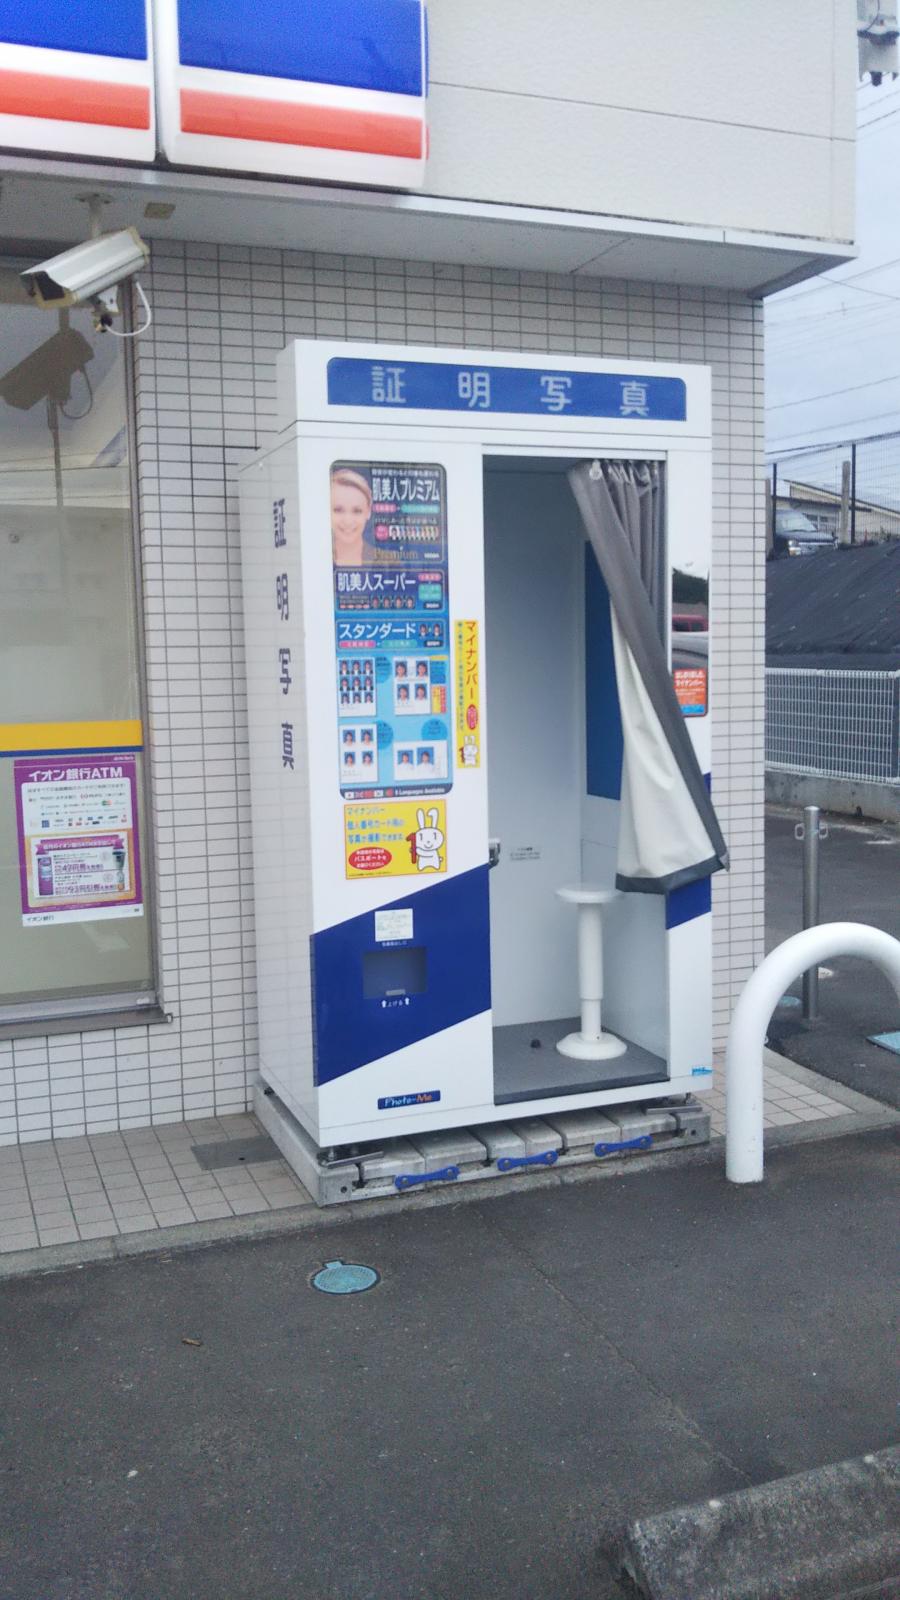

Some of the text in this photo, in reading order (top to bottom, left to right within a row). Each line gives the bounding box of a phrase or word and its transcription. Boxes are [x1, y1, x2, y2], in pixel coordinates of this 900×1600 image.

[371, 365, 650, 417] 証明写真
[372, 478, 440, 501] 肌美人プレミアム
[337, 573, 416, 592] 肌美人スーパー
[339, 623, 416, 639] スタンダード
[465, 621, 479, 699] マイナンバー
[29, 767, 123, 782] イオン銀行ATM
